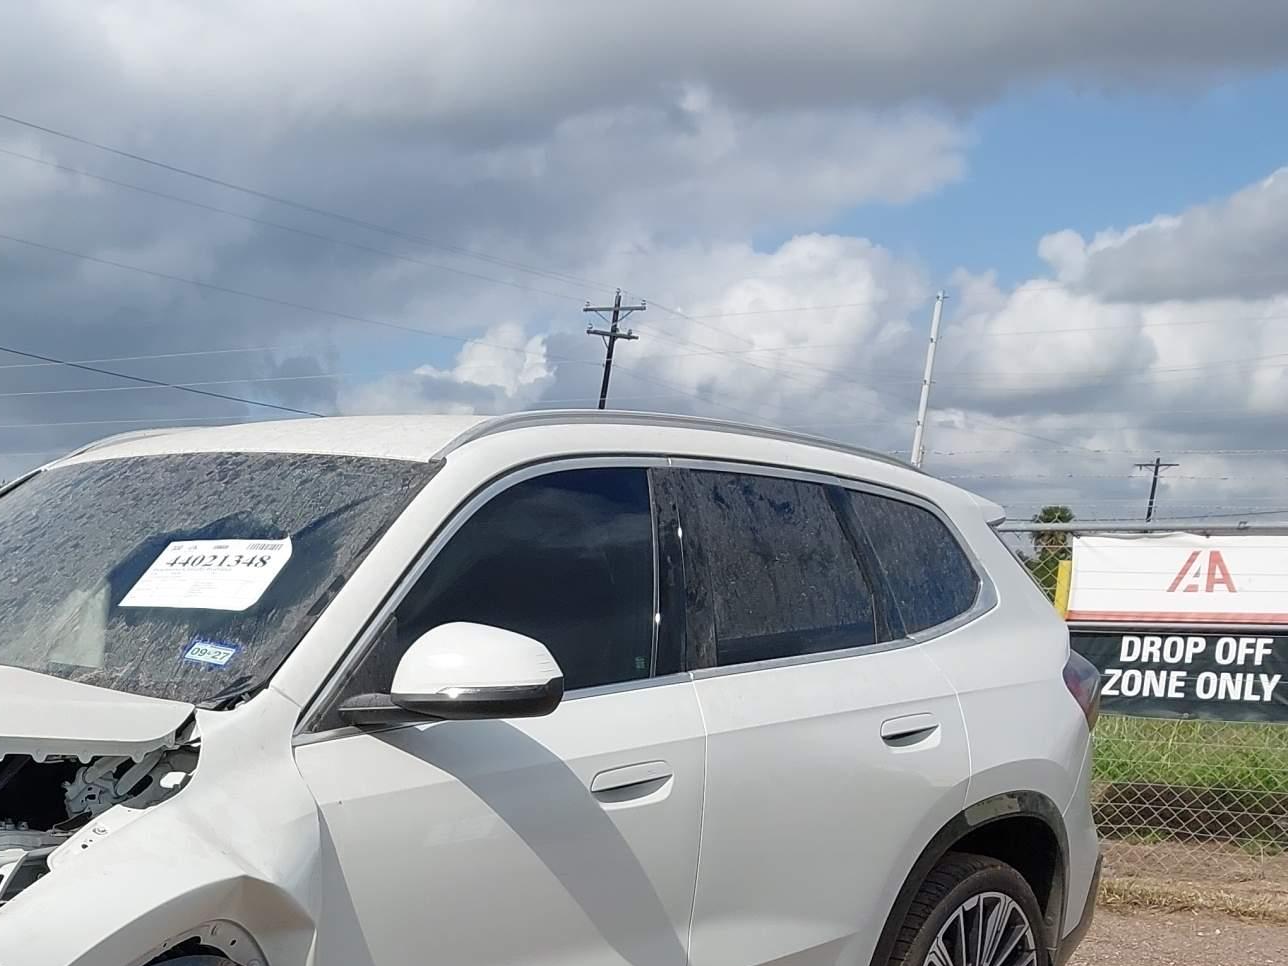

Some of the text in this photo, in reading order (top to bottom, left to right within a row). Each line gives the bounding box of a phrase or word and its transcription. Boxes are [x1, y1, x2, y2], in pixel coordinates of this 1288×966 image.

[166, 554, 272, 569] 44021348
[1119, 636, 1274, 666] DROP OFF
[1100, 668, 1282, 702] ZONE ONLY
